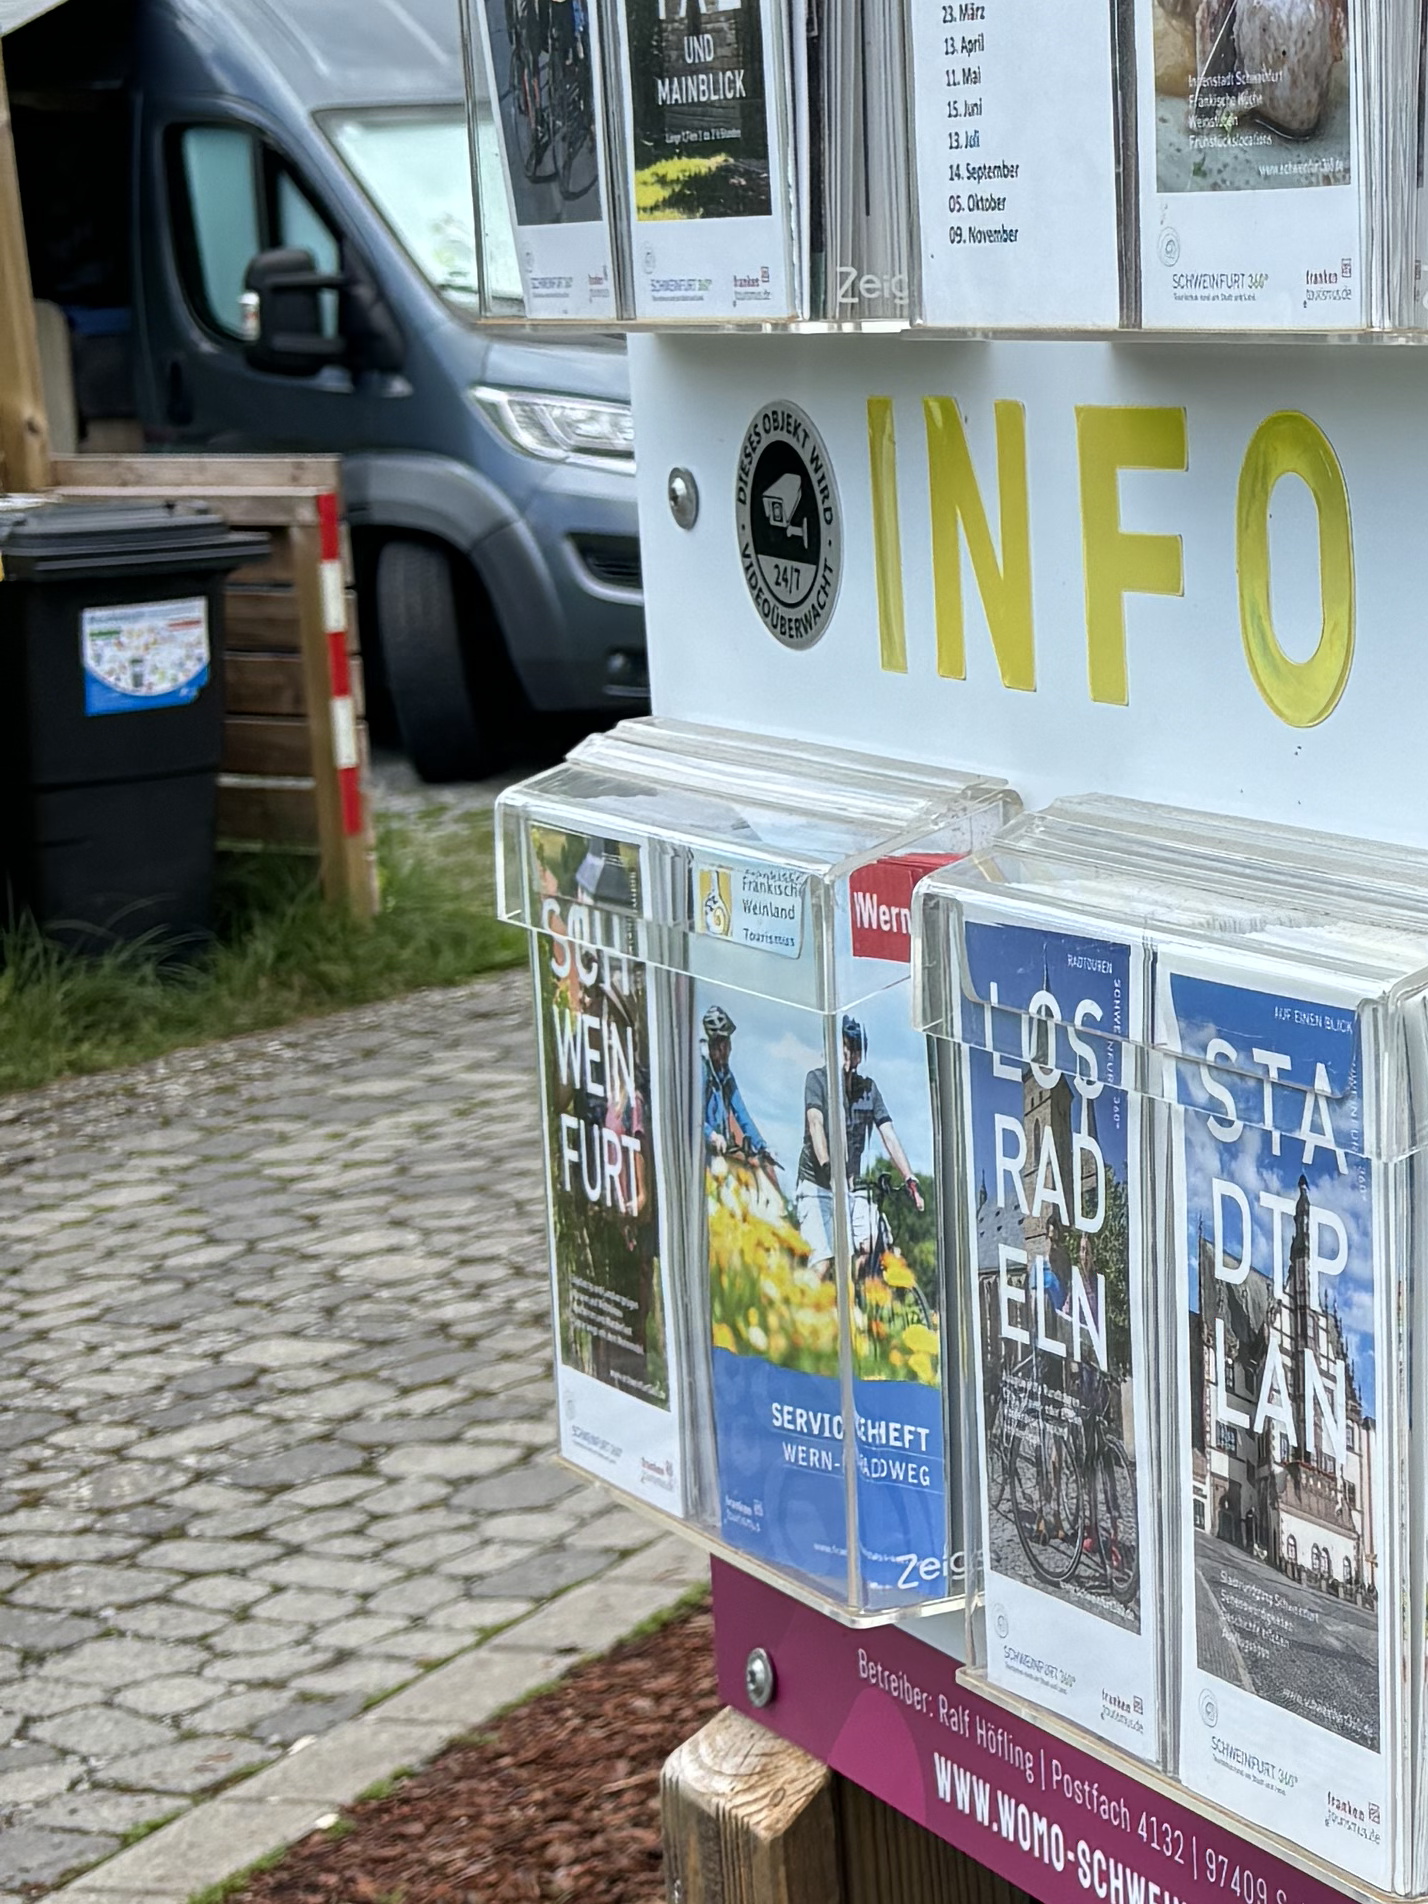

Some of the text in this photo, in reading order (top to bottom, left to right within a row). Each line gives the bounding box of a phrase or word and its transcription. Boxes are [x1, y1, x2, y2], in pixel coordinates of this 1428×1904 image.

[684, 34, 714, 64] UND
[942, 2, 985, 23] 23. März
[944, 34, 984, 56] 13. April
[658, 69, 746, 105] MAINBLICK
[949, 162, 1019, 182] 14. September
[949, 225, 1019, 245] 09. November
[737, 410, 834, 525] DIESES OBJEKT WIRD
[742, 542, 834, 639] VIDEOÜBERWACHT
[774, 564, 800, 594] 24/7
[866, 395, 1354, 728] INFO
[542, 897, 630, 997] SCH
[552, 1004, 636, 1109] WEIN
[990, 981, 1103, 1100] LOS
[1200, 1037, 1348, 1175] STA
[560, 1112, 642, 1218] FURT
[994, 1112, 1105, 1234] RAD
[1212, 1177, 1349, 1312] DTP
[998, 1243, 1108, 1373] ELN
[1215, 1318, 1348, 1465] LAN
[858, 1647, 933, 1725] Betreiber:
[938, 1695, 971, 1739] Ralf
[977, 1715, 1034, 1788] Höfling
[1052, 1759, 1130, 1833] Postfach
[1137, 1809, 1186, 1864] 4132
